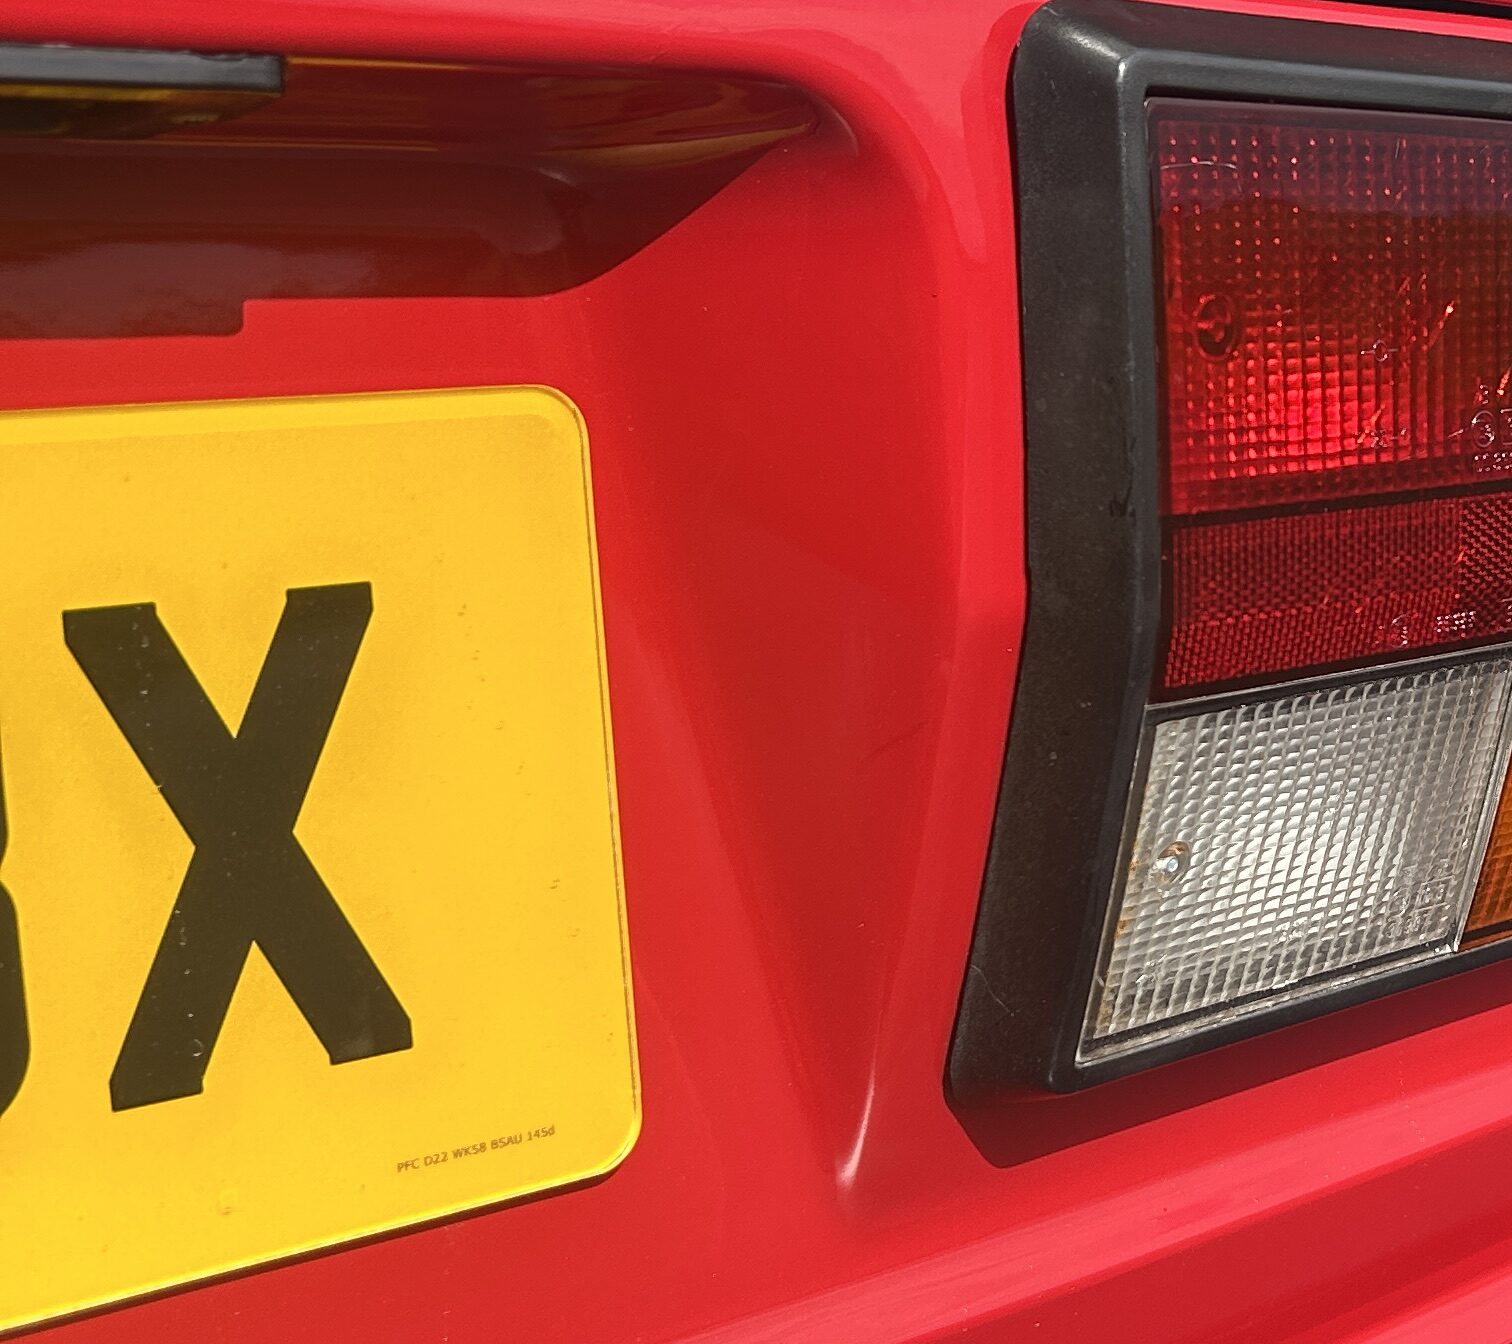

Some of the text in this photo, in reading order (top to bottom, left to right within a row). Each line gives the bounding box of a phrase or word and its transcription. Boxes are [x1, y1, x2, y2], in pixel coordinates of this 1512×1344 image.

[0, 581, 413, 1117] X
[490, 1133, 523, 1150] BSAU
[526, 1124, 555, 1142] 145d
